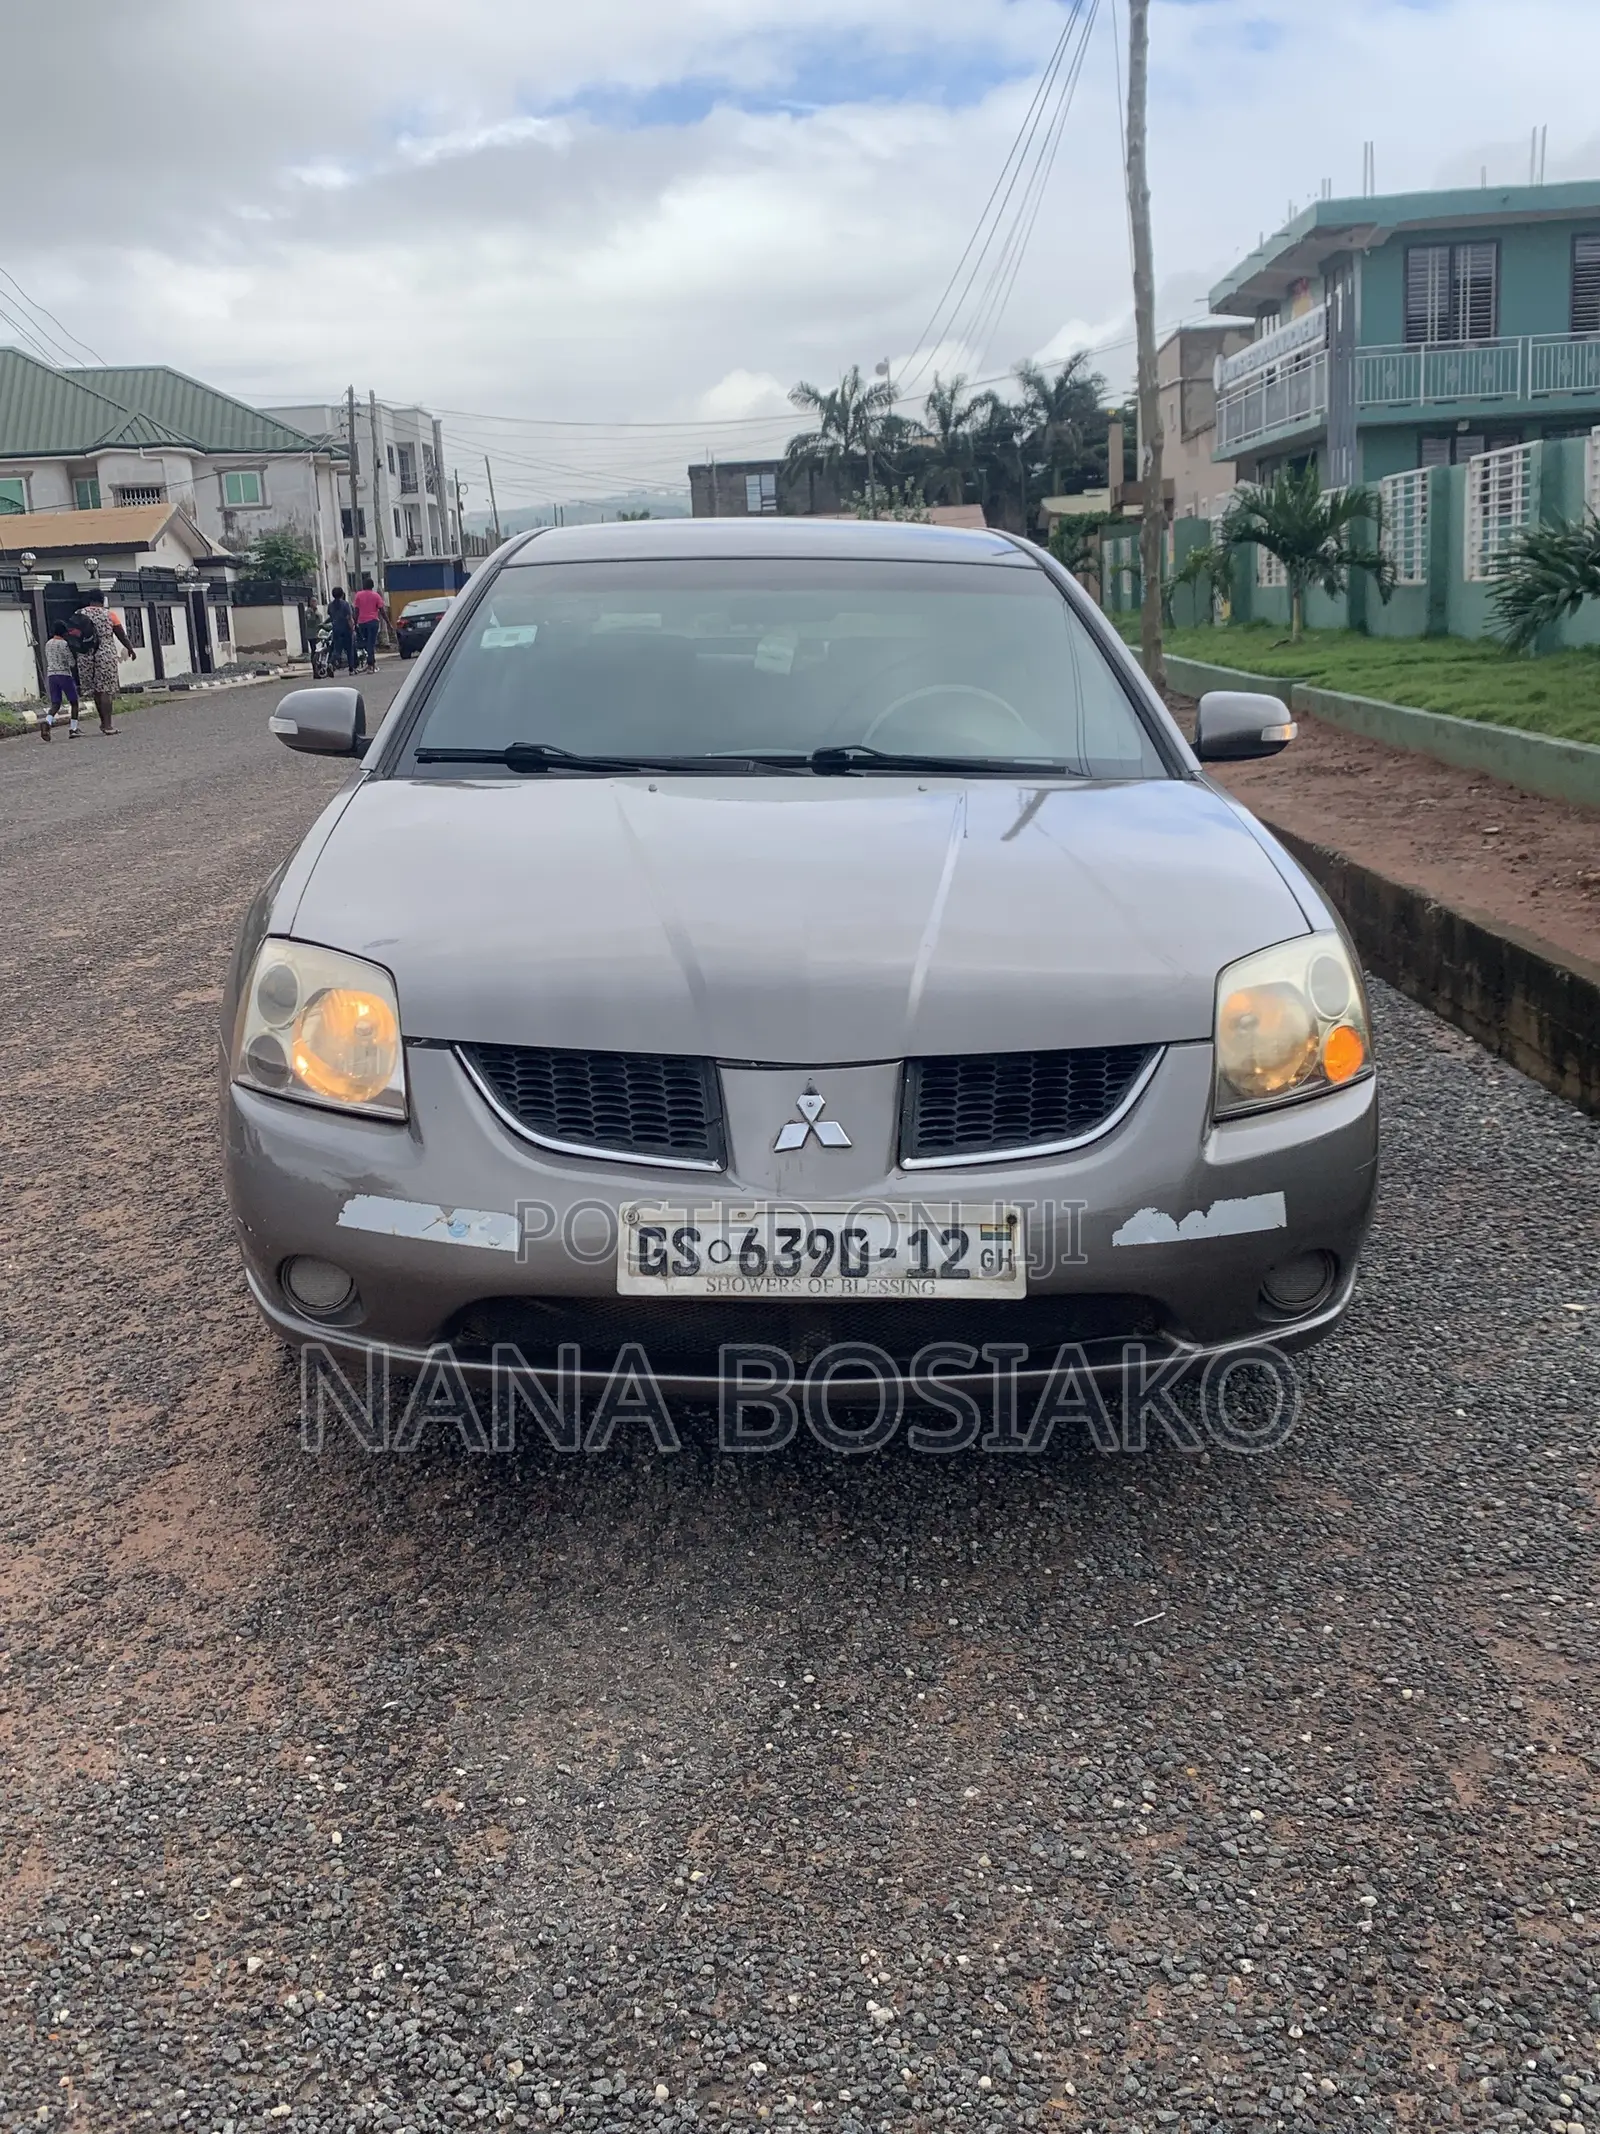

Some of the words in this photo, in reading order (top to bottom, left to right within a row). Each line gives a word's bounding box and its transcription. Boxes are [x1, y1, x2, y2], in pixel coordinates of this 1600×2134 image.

[638, 1226, 701, 1277] GS
[980, 1248, 1013, 1272] GH
[706, 1278, 801, 1293] SHOWERS
[808, 1279, 834, 1294] OF
[840, 1279, 936, 1296] BLESSING
